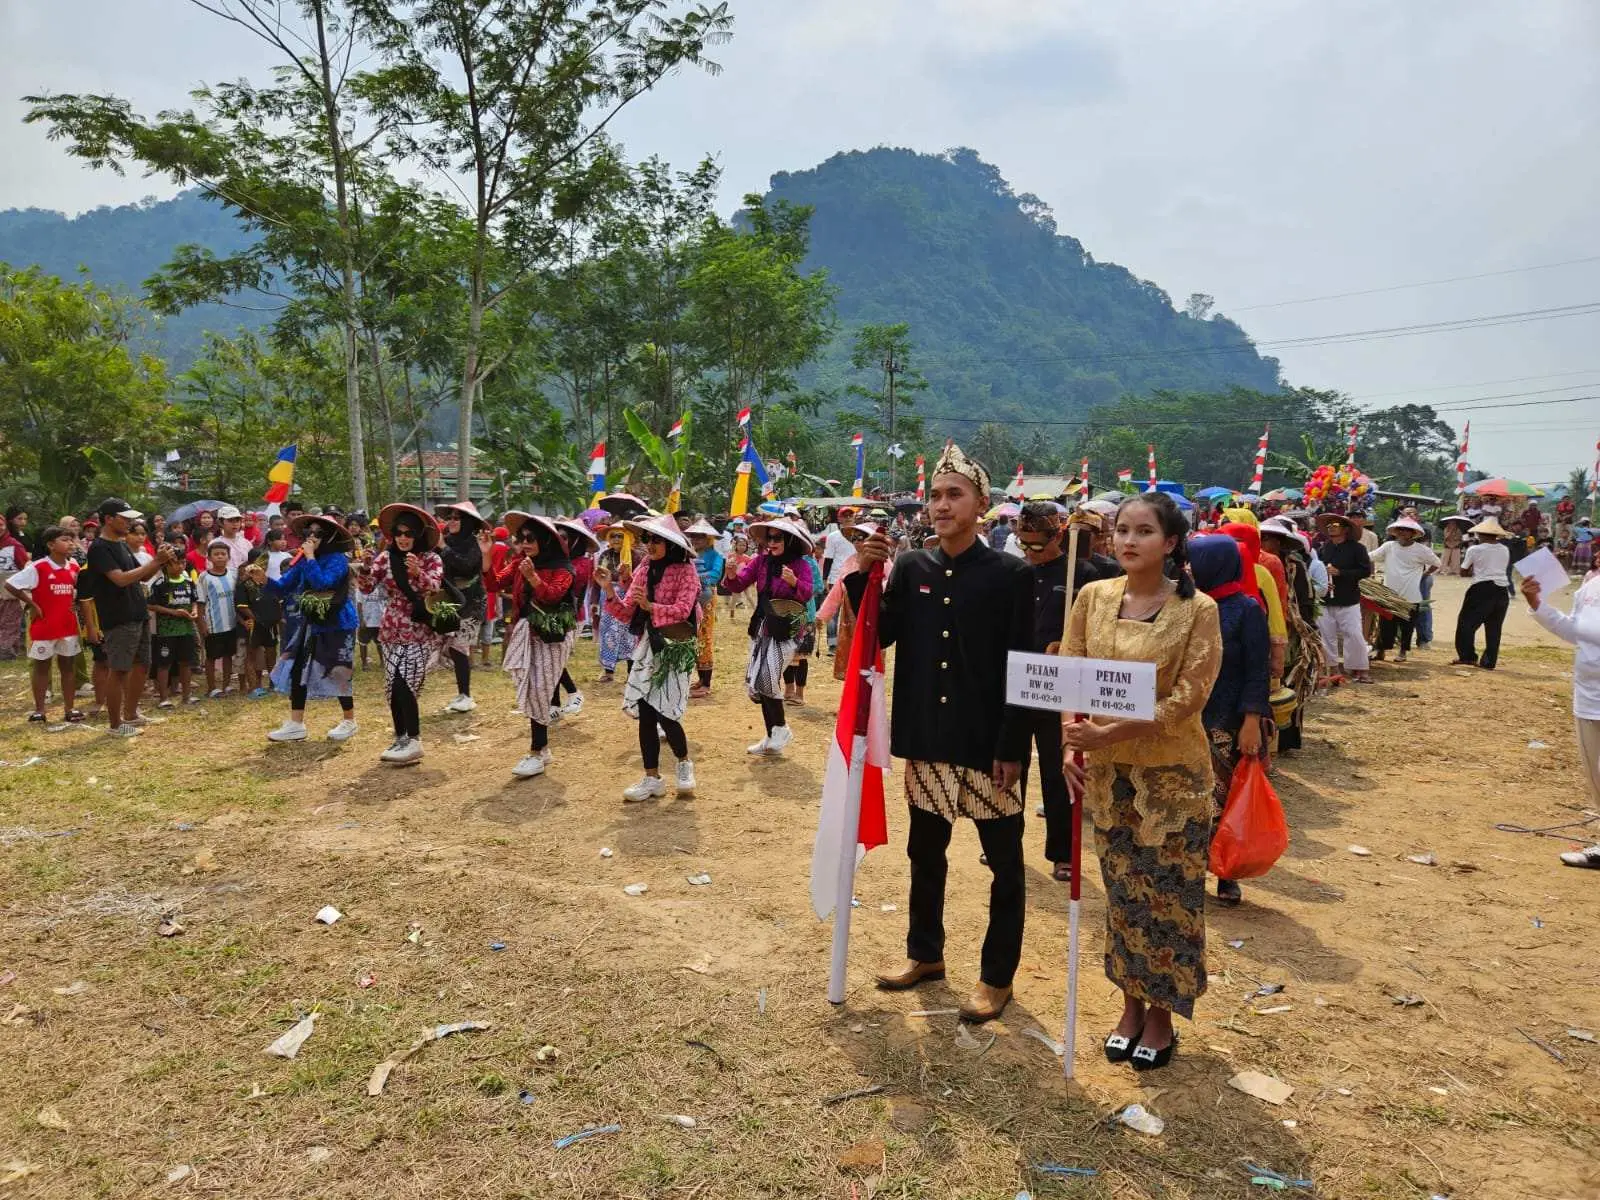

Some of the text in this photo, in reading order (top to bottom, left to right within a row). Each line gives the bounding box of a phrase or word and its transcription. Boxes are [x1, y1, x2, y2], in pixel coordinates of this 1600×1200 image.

[1026, 663, 1059, 677] PETANI
[1095, 669, 1131, 684] PETANI
[1029, 679, 1054, 691] RW 02
[1031, 692, 1062, 703] 01-02-03
[1100, 686, 1127, 698] RW 02
[1090, 699, 1136, 711] RT 01-02-03
